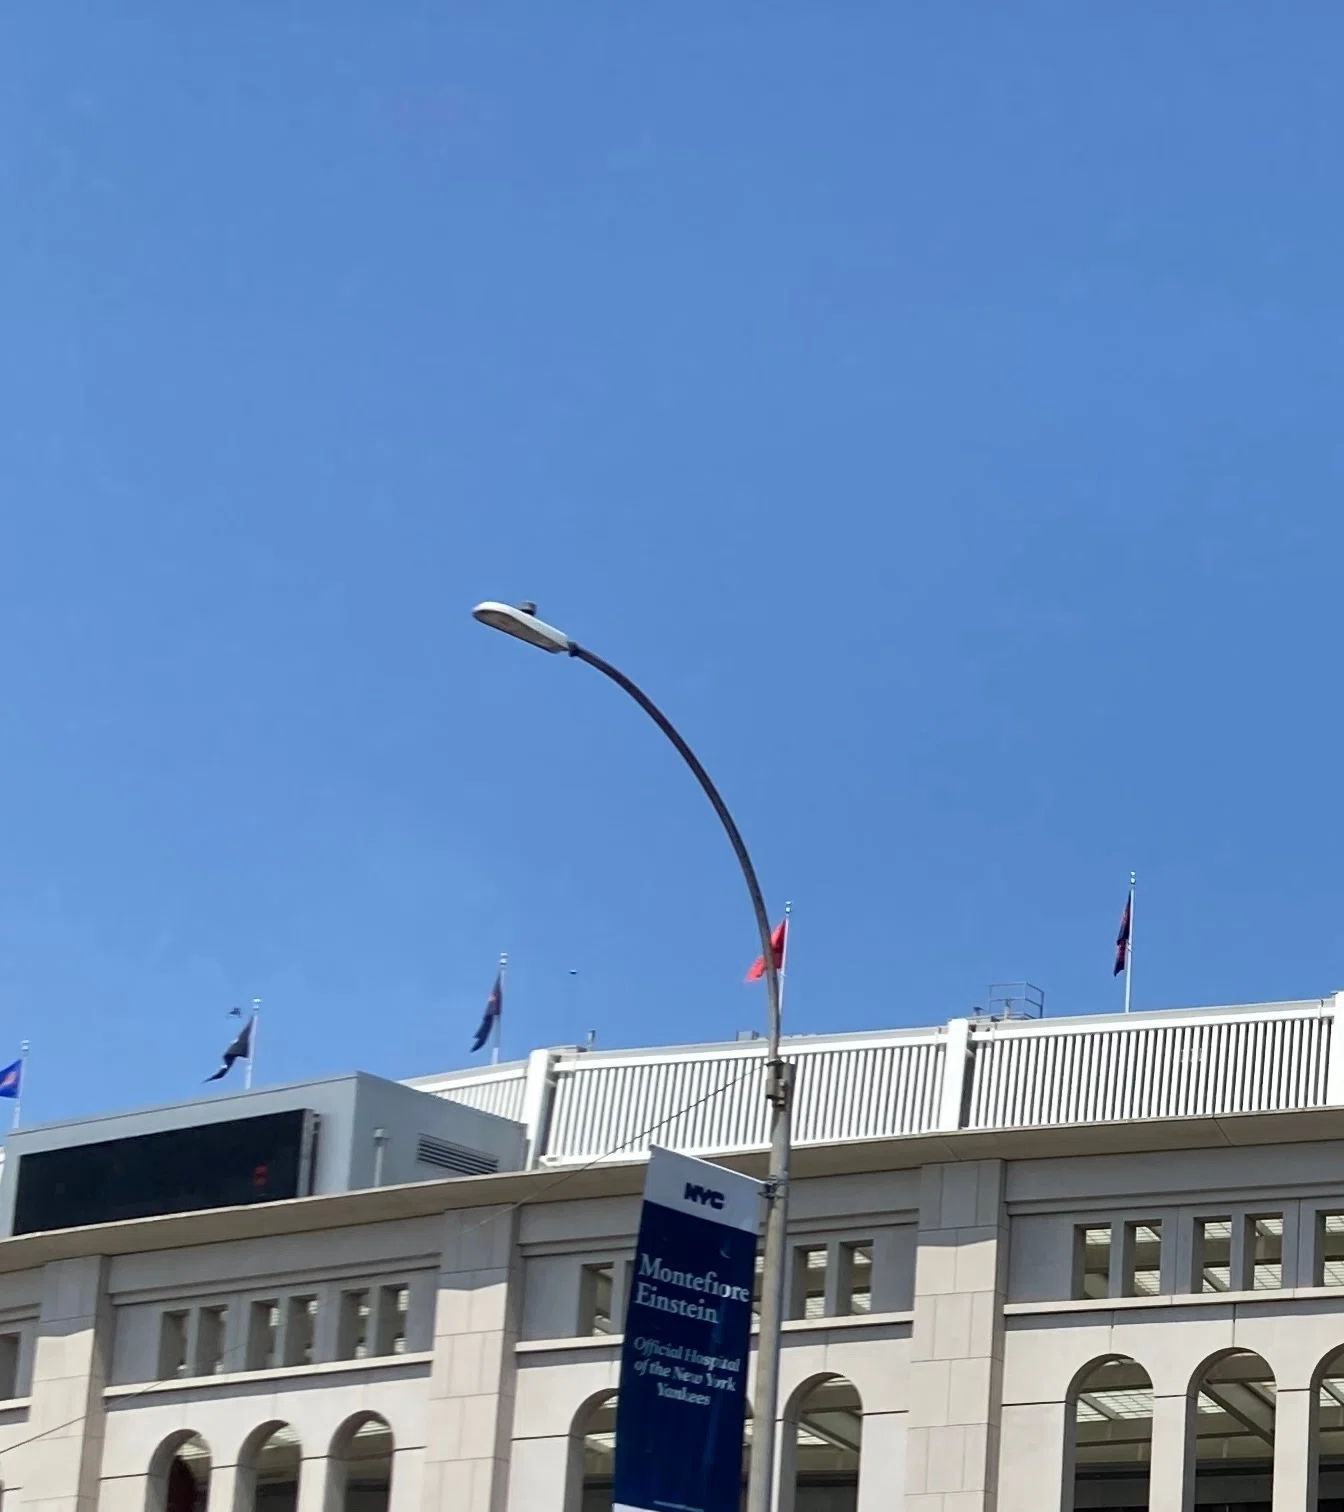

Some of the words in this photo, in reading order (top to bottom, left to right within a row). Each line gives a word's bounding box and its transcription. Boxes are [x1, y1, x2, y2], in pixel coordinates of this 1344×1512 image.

[683, 1182, 725, 1210] NYC
[638, 1252, 750, 1302] Montefiore
[634, 1282, 719, 1324] Einstein
[633, 1336, 683, 1359] Official
[684, 1347, 741, 1372] Hospital
[633, 1359, 650, 1376] of
[649, 1361, 671, 1377] the
[672, 1366, 703, 1384] New
[705, 1373, 736, 1391] York
[657, 1382, 711, 1405] Yankees
